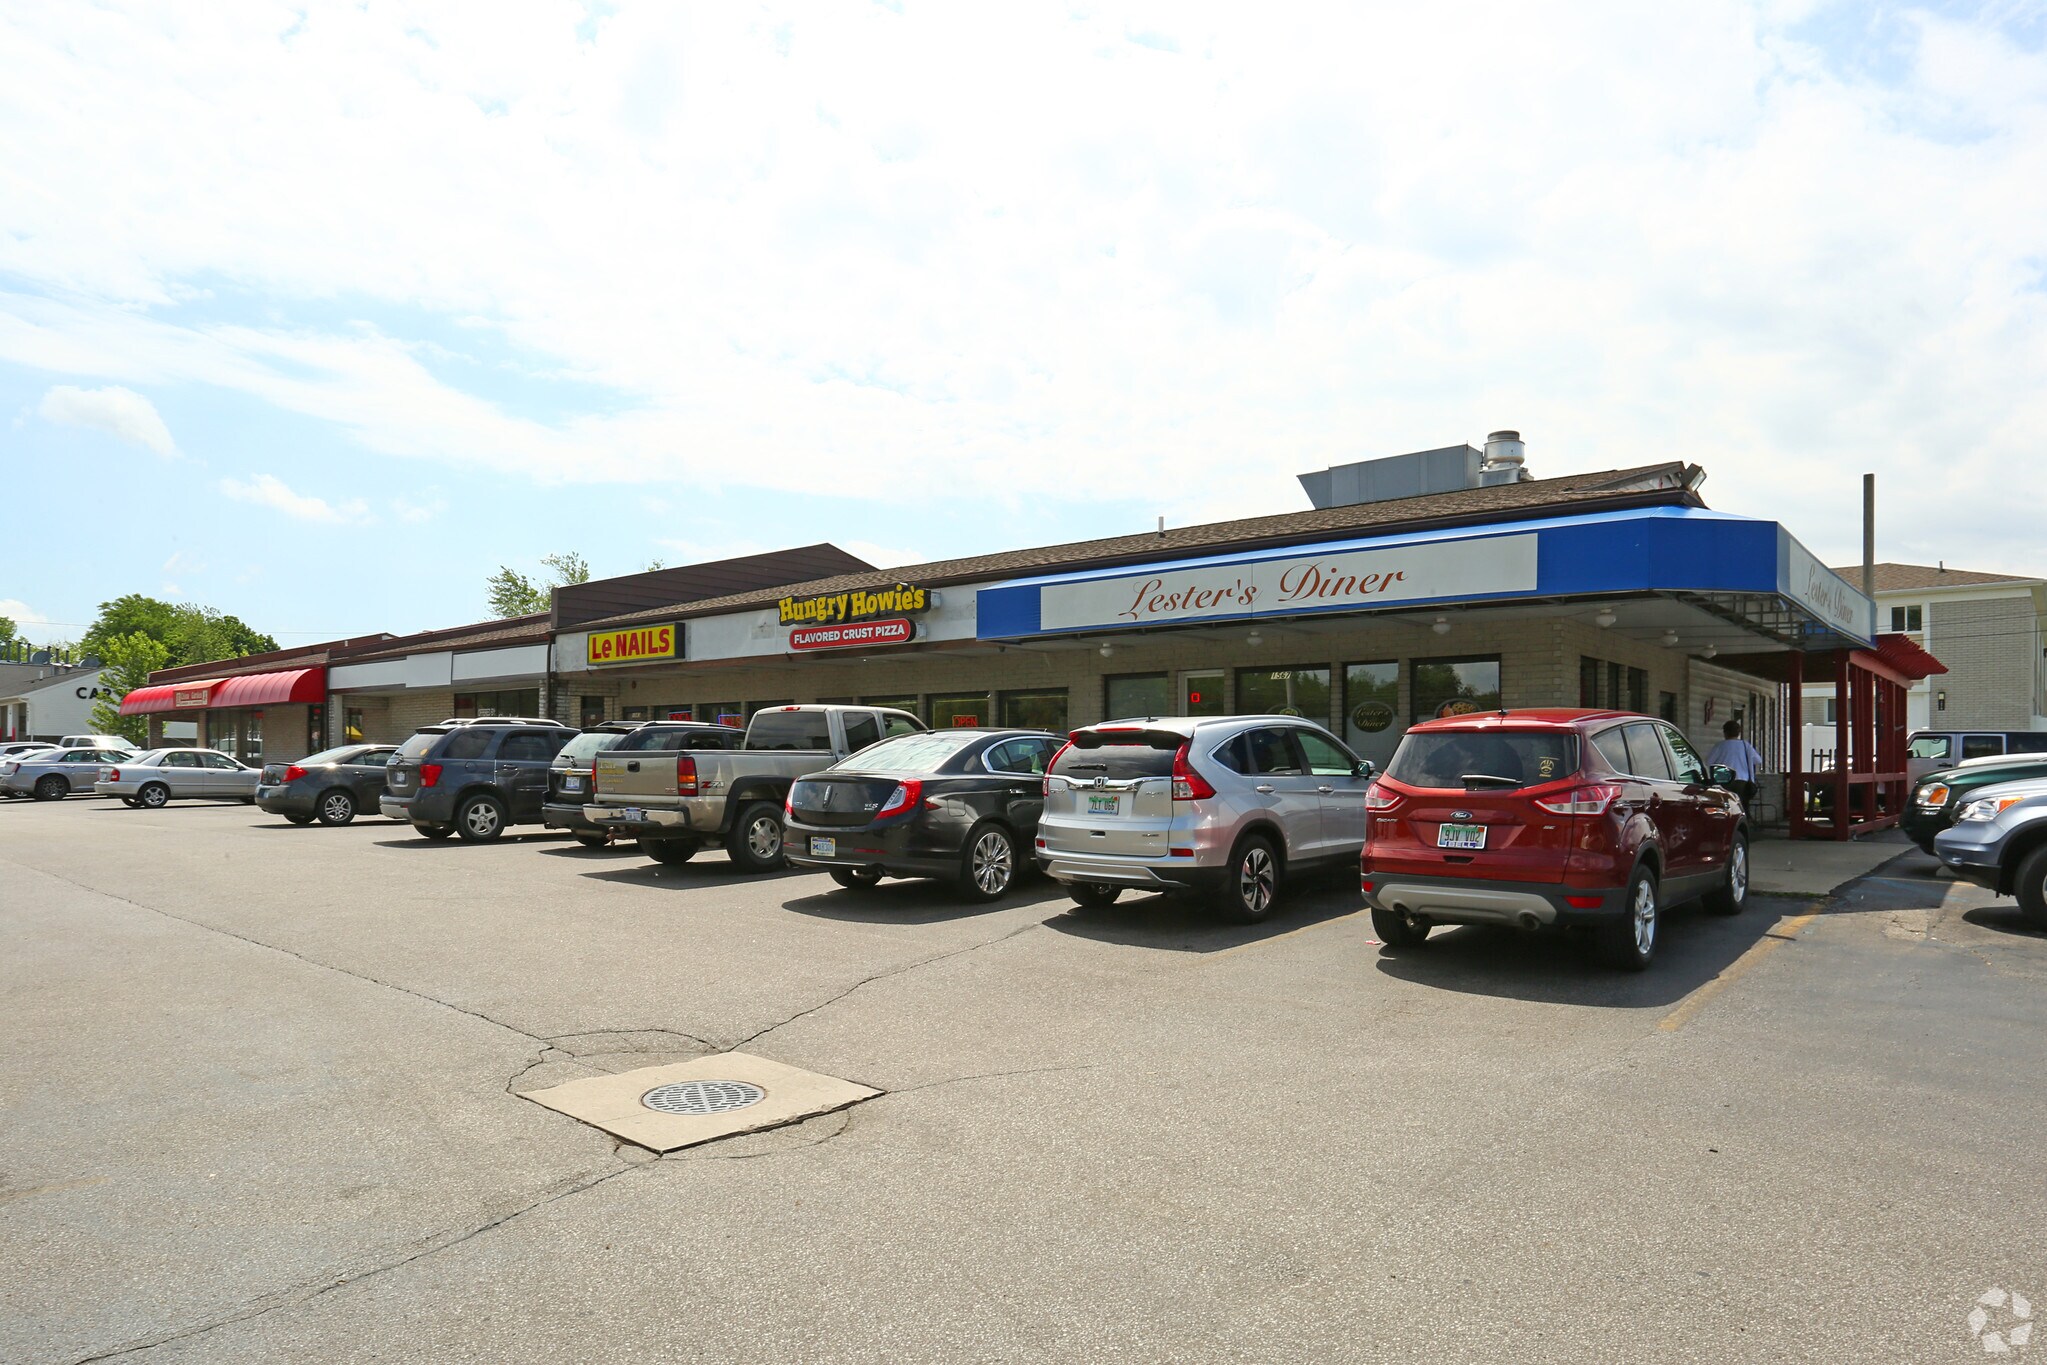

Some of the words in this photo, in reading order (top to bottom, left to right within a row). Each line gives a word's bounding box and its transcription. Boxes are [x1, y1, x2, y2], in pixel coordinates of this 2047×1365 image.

[778, 593, 848, 622] Hungry
[851, 584, 925, 616] Howie's
[1118, 578, 1263, 620] Lester's
[1278, 561, 1408, 602] Diner
[592, 637, 612, 659] Le
[615, 628, 670, 657] NAILS
[793, 631, 841, 645] FLAVORED
[842, 627, 874, 640] CRUST
[875, 624, 905, 637] PIZZA
[954, 717, 978, 727] OPEN
[701, 781, 726, 790] Z71
